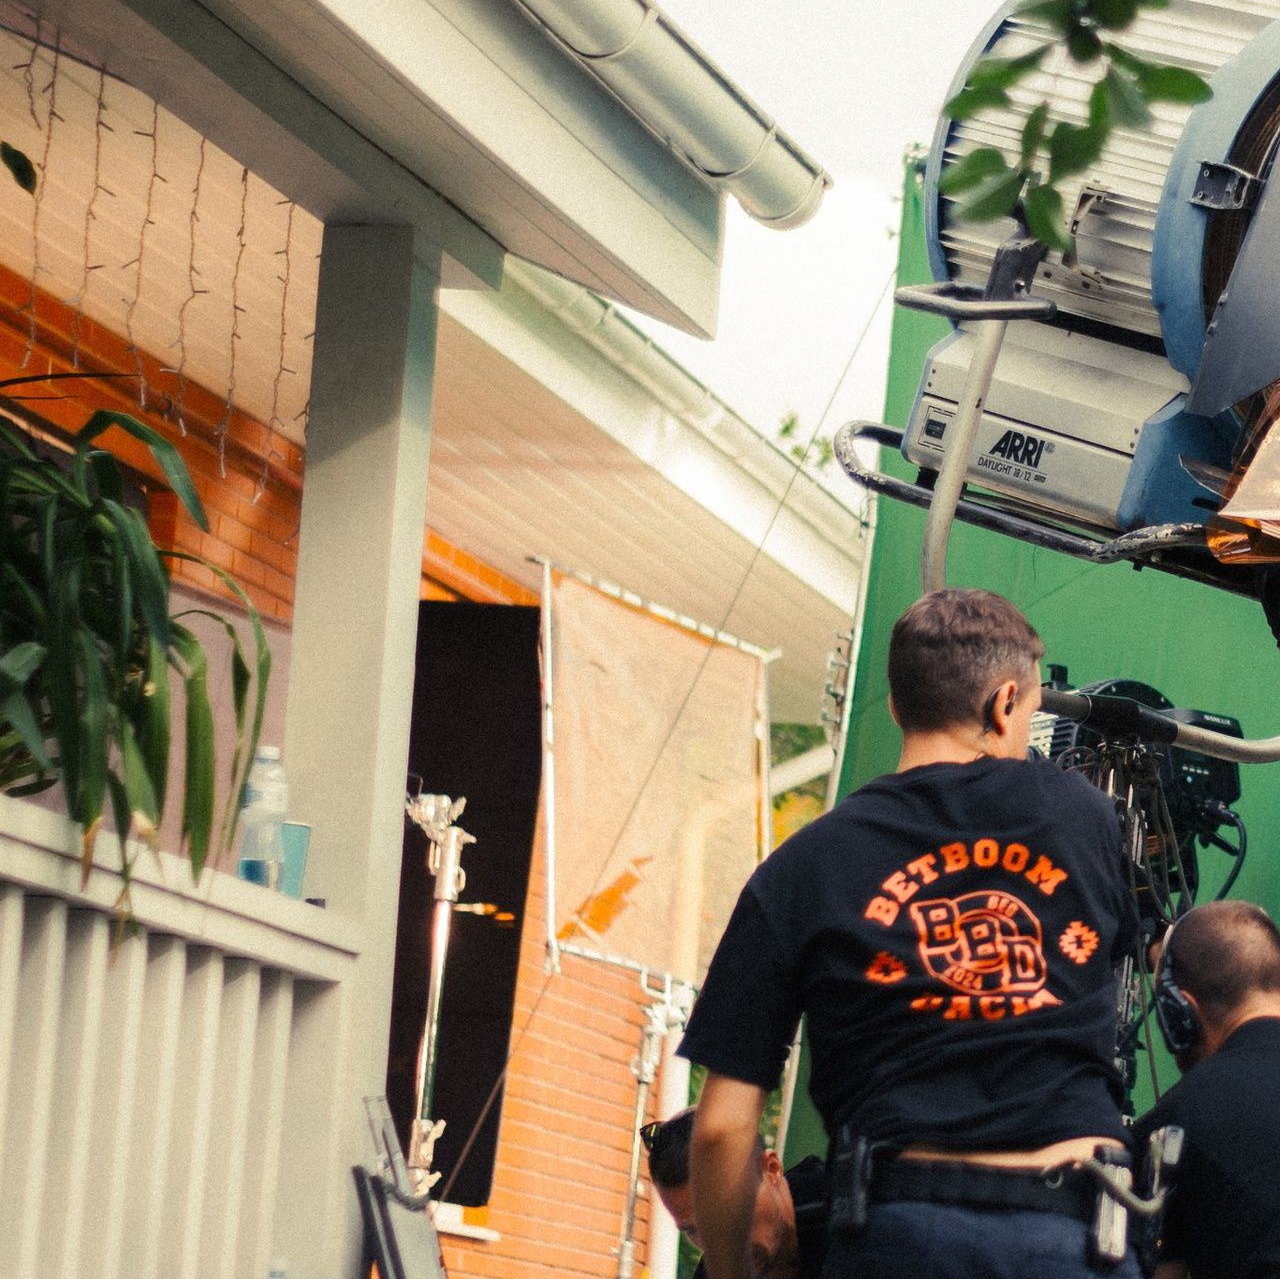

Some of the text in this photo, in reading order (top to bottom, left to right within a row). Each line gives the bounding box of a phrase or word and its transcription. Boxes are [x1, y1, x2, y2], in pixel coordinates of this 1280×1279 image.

[977, 456, 1012, 476] DAYLIGHT
[988, 430, 1046, 469] ARRI
[864, 838, 1068, 927] BETBOOM
